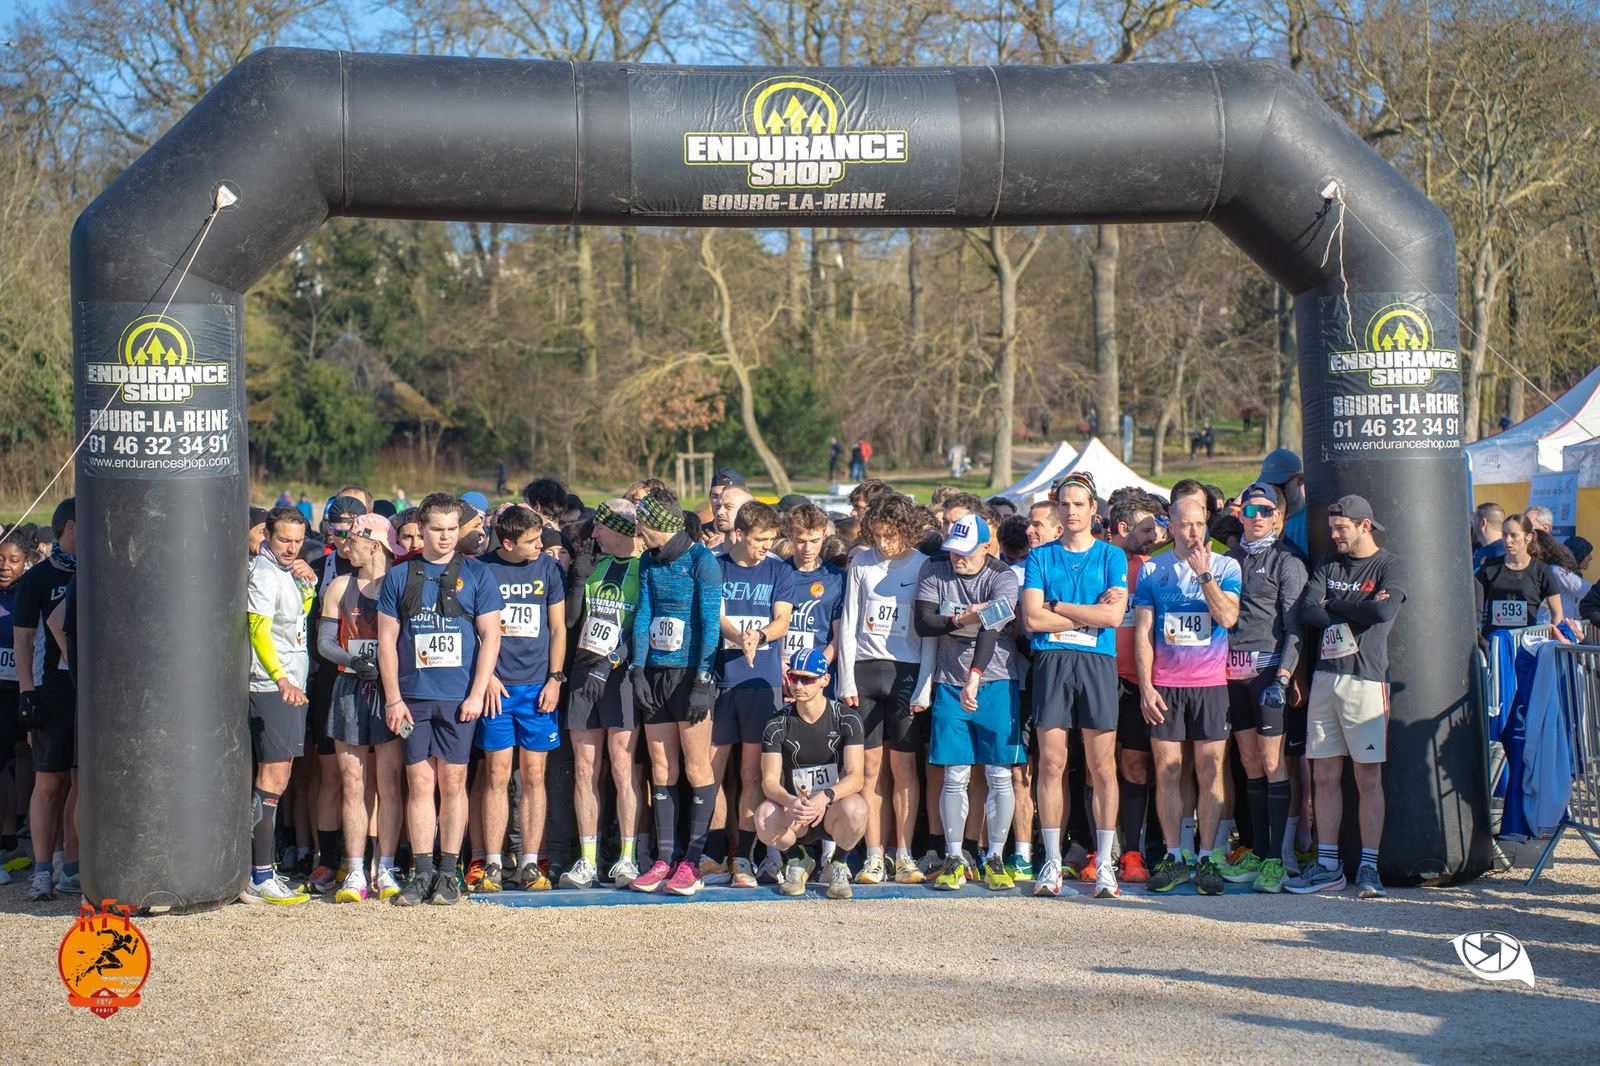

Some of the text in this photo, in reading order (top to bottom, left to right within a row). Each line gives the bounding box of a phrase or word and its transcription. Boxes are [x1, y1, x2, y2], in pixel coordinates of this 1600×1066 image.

[687, 134, 905, 161] ENDURANCE
[751, 161, 842, 186] SHOP
[702, 193, 887, 211] BOURG-LA-REINE
[1330, 351, 1458, 371] ENDURANCE
[88, 365, 228, 383] ENDURANCE
[1371, 368, 1432, 385] SHOP
[123, 383, 191, 401] SHOP
[1333, 393, 1460, 417] BOURG-LA-REINE
[89, 409, 229, 433] BOURG-LA-REINE
[1333, 417, 1460, 438] 01 46 32 34 91
[89, 433, 228, 456] 01 46 32 34 91
[1333, 438, 1460, 451] www.enduranceshop.com
[89, 456, 230, 470] www.enduranceshop.com
[510, 605, 532, 624] 719
[878, 605, 900, 622] 874
[1501, 603, 1523, 617] 593
[590, 622, 611, 641] 916
[659, 620, 674, 637] 918
[1178, 615, 1202, 632] 148
[429, 635, 455, 653] 463
[784, 634, 805, 651] 144
[1325, 627, 1343, 645] 904
[1231, 651, 1253, 668] 604
[807, 768, 830, 787] 751
